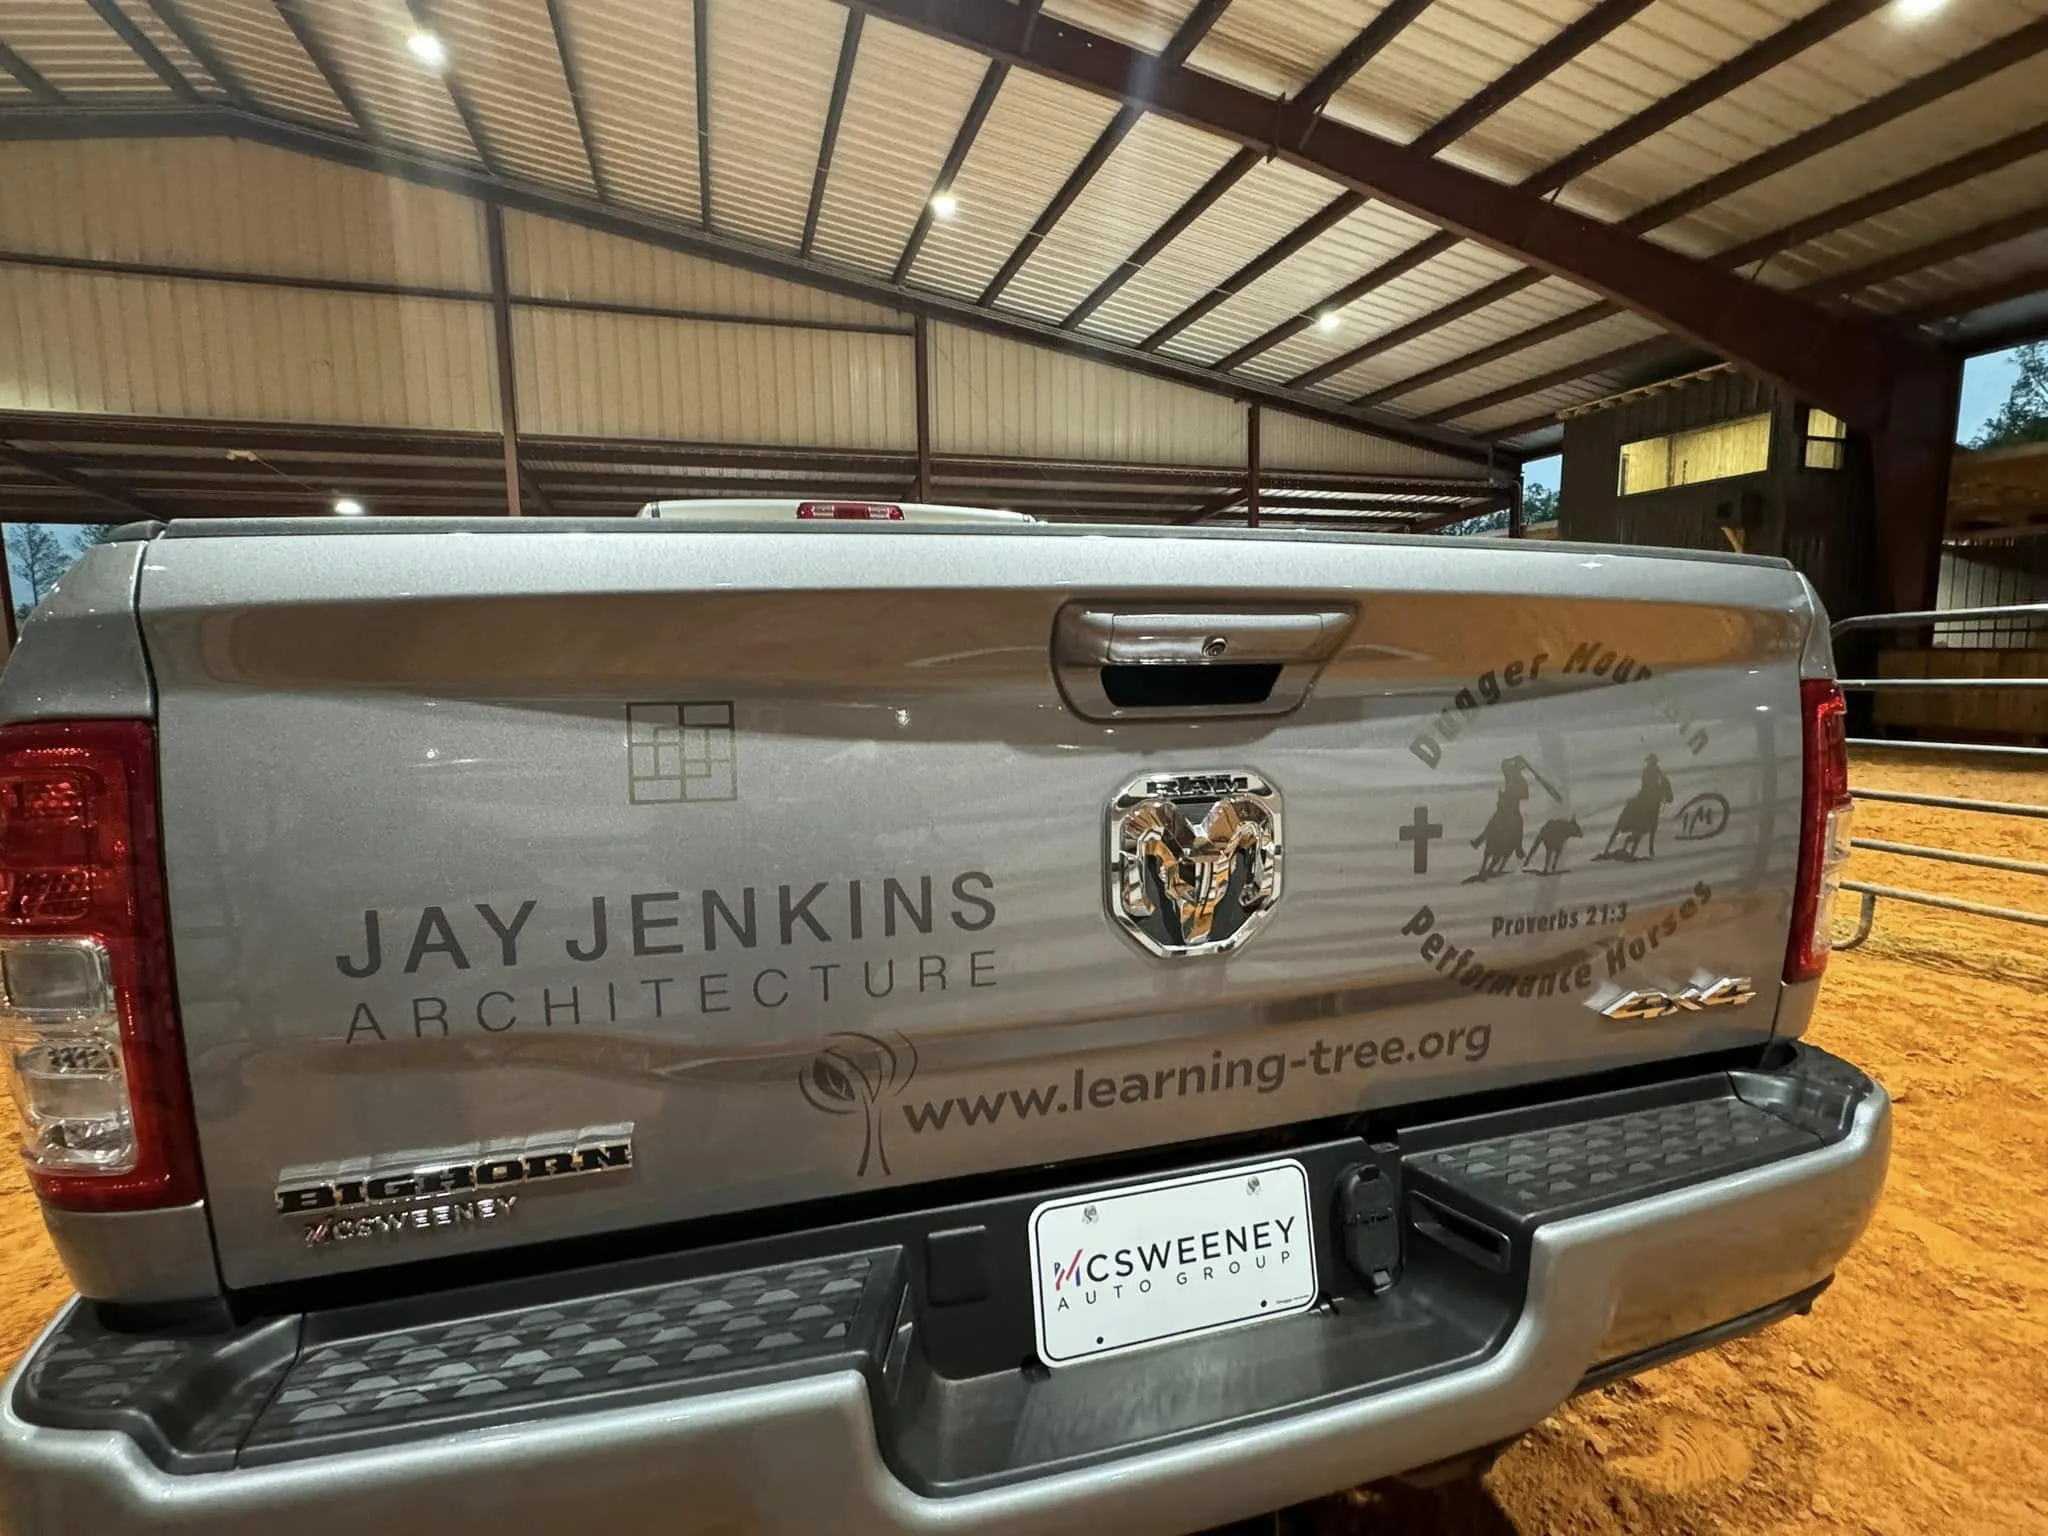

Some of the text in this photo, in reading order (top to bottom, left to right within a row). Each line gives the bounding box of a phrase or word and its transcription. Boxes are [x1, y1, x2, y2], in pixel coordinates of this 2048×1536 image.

[1146, 775, 1248, 796] RAM
[336, 871, 996, 978] JAY JENKINS
[1402, 880, 1712, 998] Performance Horses
[1491, 902, 1627, 939] Proverbs 21:3
[345, 950, 997, 1044] ARCHITECTURE
[903, 1023, 1492, 1134] www.learning-tree.org
[1054, 1216, 1295, 1290] MCSWEENEY
[1057, 1250, 1290, 1312] AUTO GROUP
